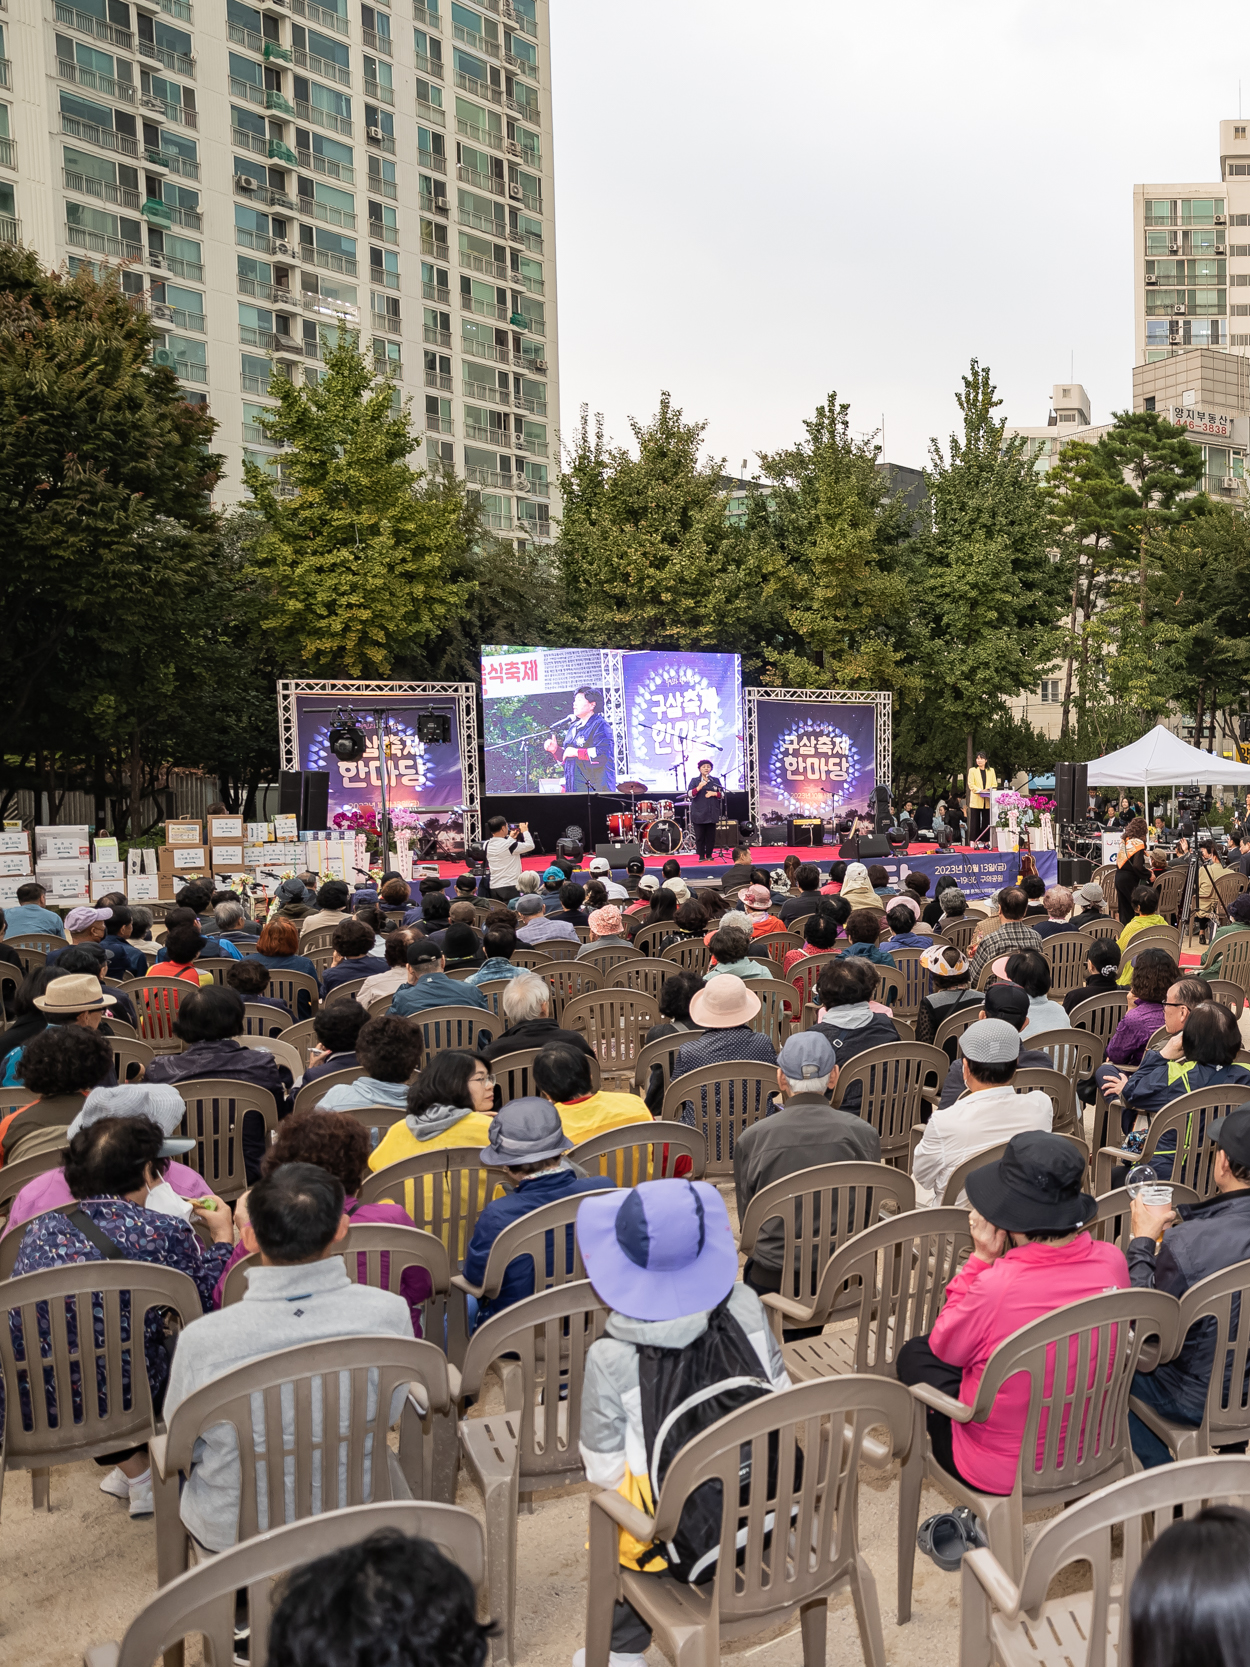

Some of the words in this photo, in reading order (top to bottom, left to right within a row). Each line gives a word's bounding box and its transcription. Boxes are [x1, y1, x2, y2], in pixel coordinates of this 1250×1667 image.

[1174, 407, 1230, 426] 양지부동산
[1175, 418, 1227, 435] 446-3838
[651, 686, 719, 719] 구삼축제
[782, 735, 850, 756] 구삼축제
[337, 759, 429, 789] 한마당
[783, 755, 850, 781] 한마당
[934, 865, 963, 875] 2023년
[964, 864, 979, 874] 10월
[980, 863, 1007, 873] 13일(금)
[980, 874, 1004, 883] 구의공원
